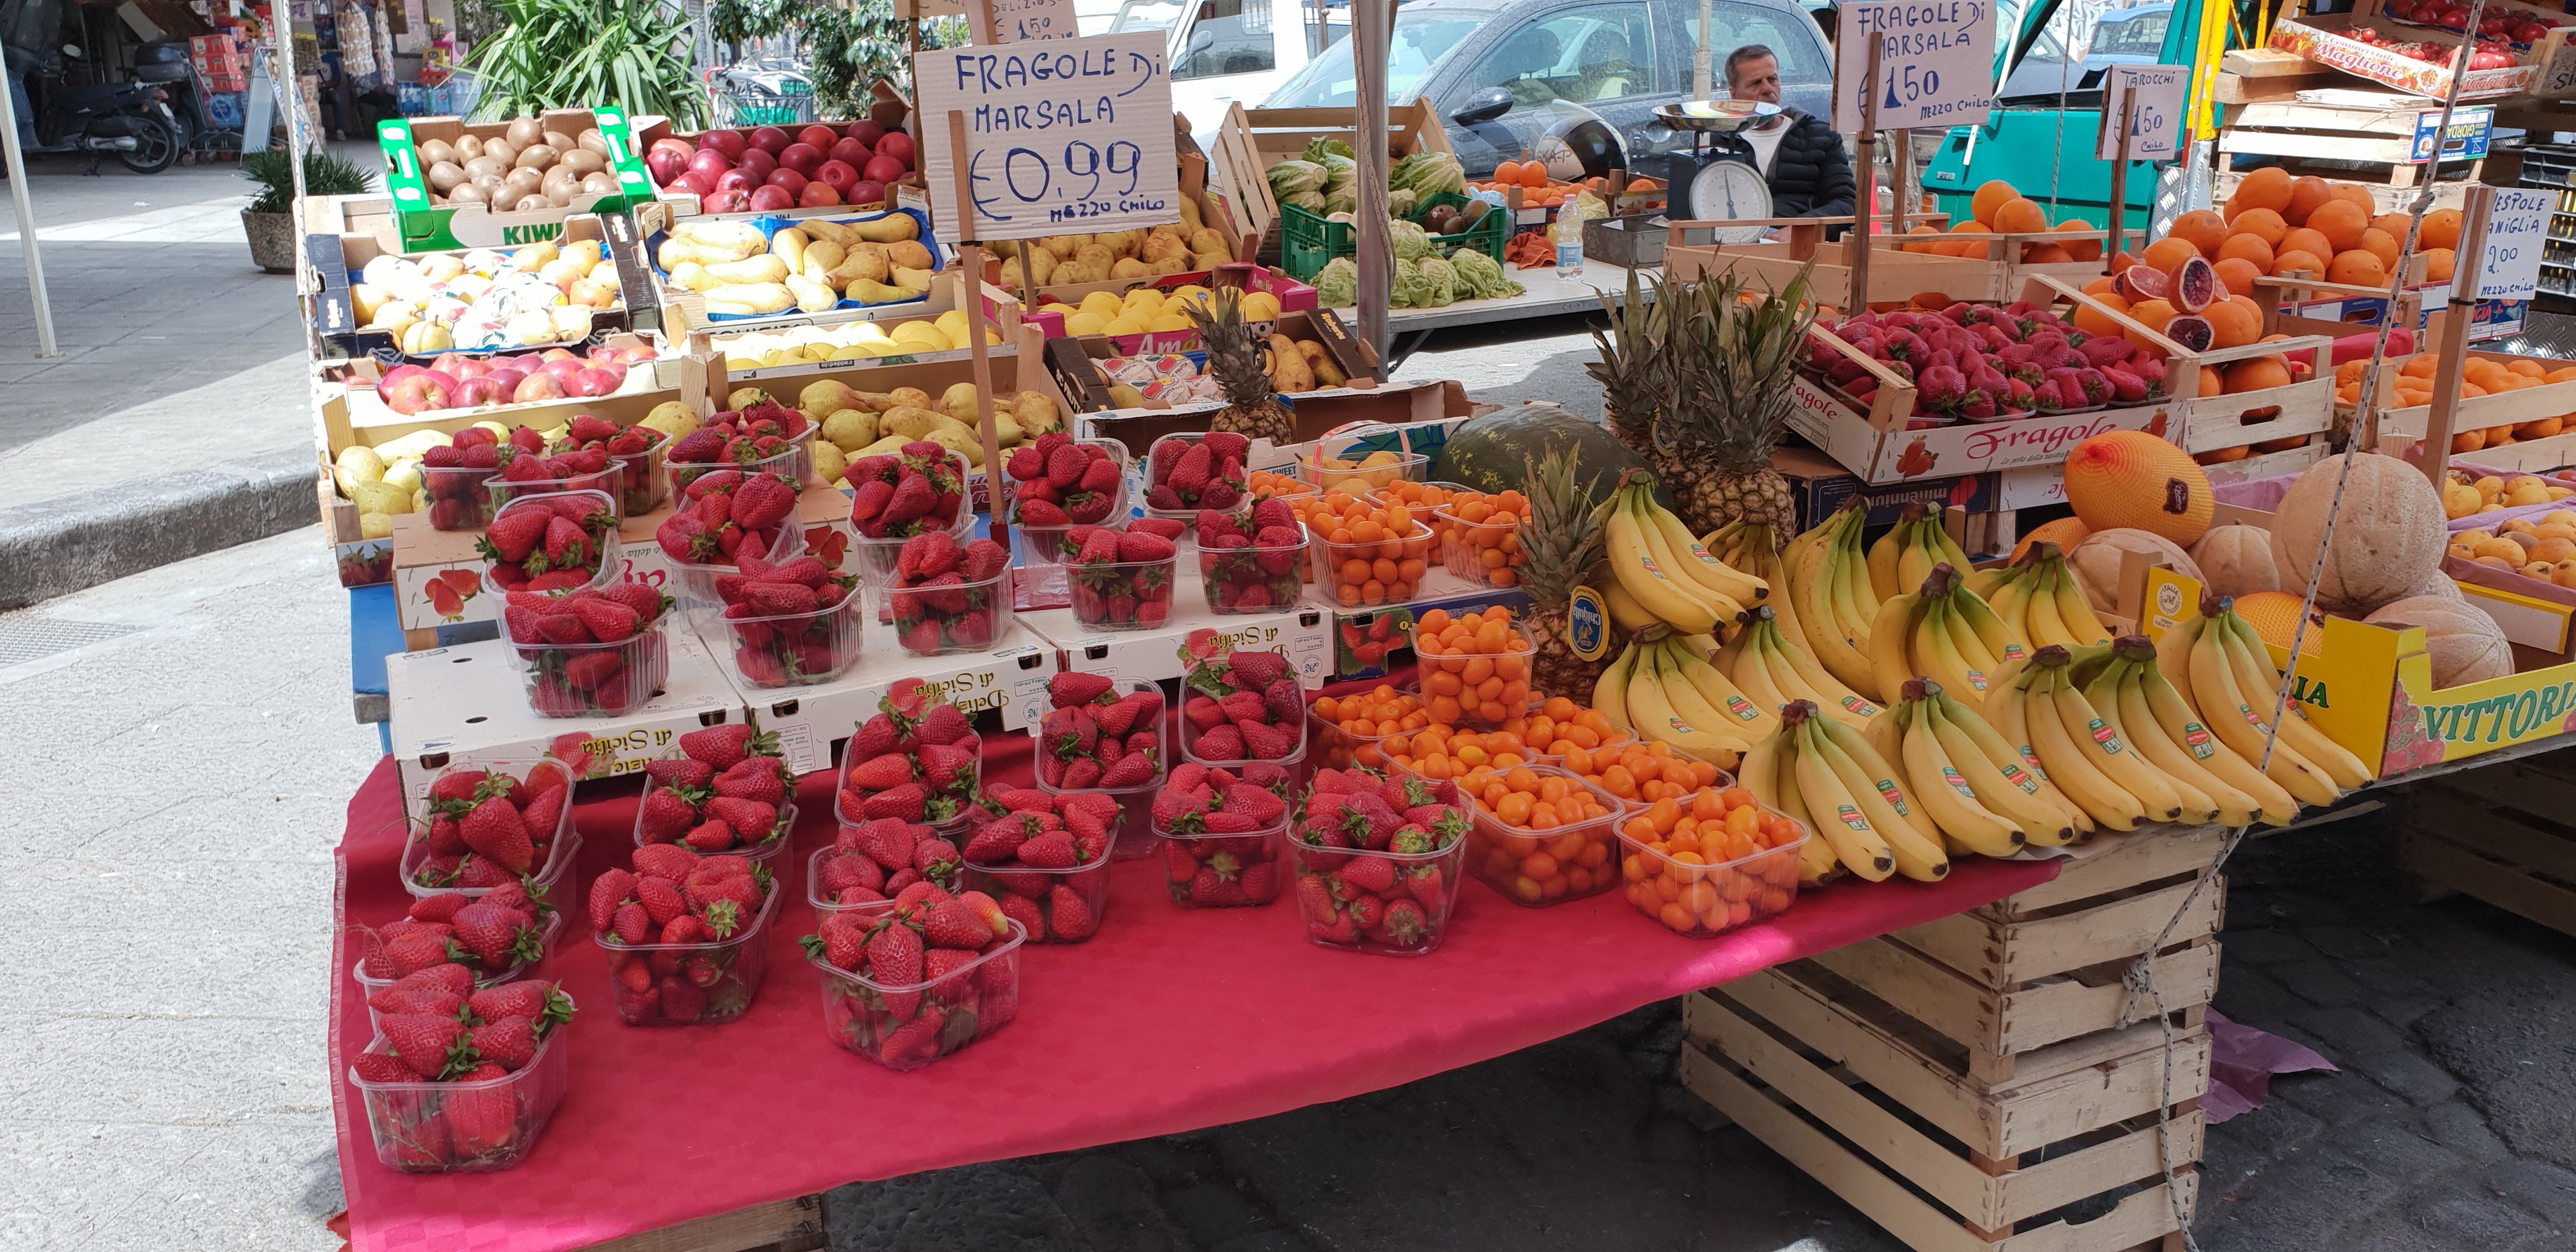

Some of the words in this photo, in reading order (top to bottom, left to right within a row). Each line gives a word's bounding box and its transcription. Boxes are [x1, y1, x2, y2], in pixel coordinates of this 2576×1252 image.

[1858, 1, 1959, 37] FRAGOLE
[1882, 31, 1970, 61] ARSALA
[956, 49, 1116, 94] FRAGOLE
[2315, 43, 2404, 79] Maglione
[2553, 72, 2576, 90] SI
[975, 96, 1114, 134] MARSALA
[1920, 103, 1952, 121] MEZZO
[1050, 200, 1111, 222] MEZZO
[503, 222, 562, 245] KIWI
[2481, 285, 2508, 296] MEZZO
[1963, 416, 2117, 459] Fragole
[1871, 487, 1947, 508] millenniu
[1573, 605, 1601, 626] Chiquita
[1209, 627, 1261, 649] Sicilia
[1264, 627, 1278, 642] di
[914, 673, 974, 700] Sicilia
[979, 672, 994, 688] di
[580, 728, 648, 756] Sicilia
[654, 729, 673, 745] di
